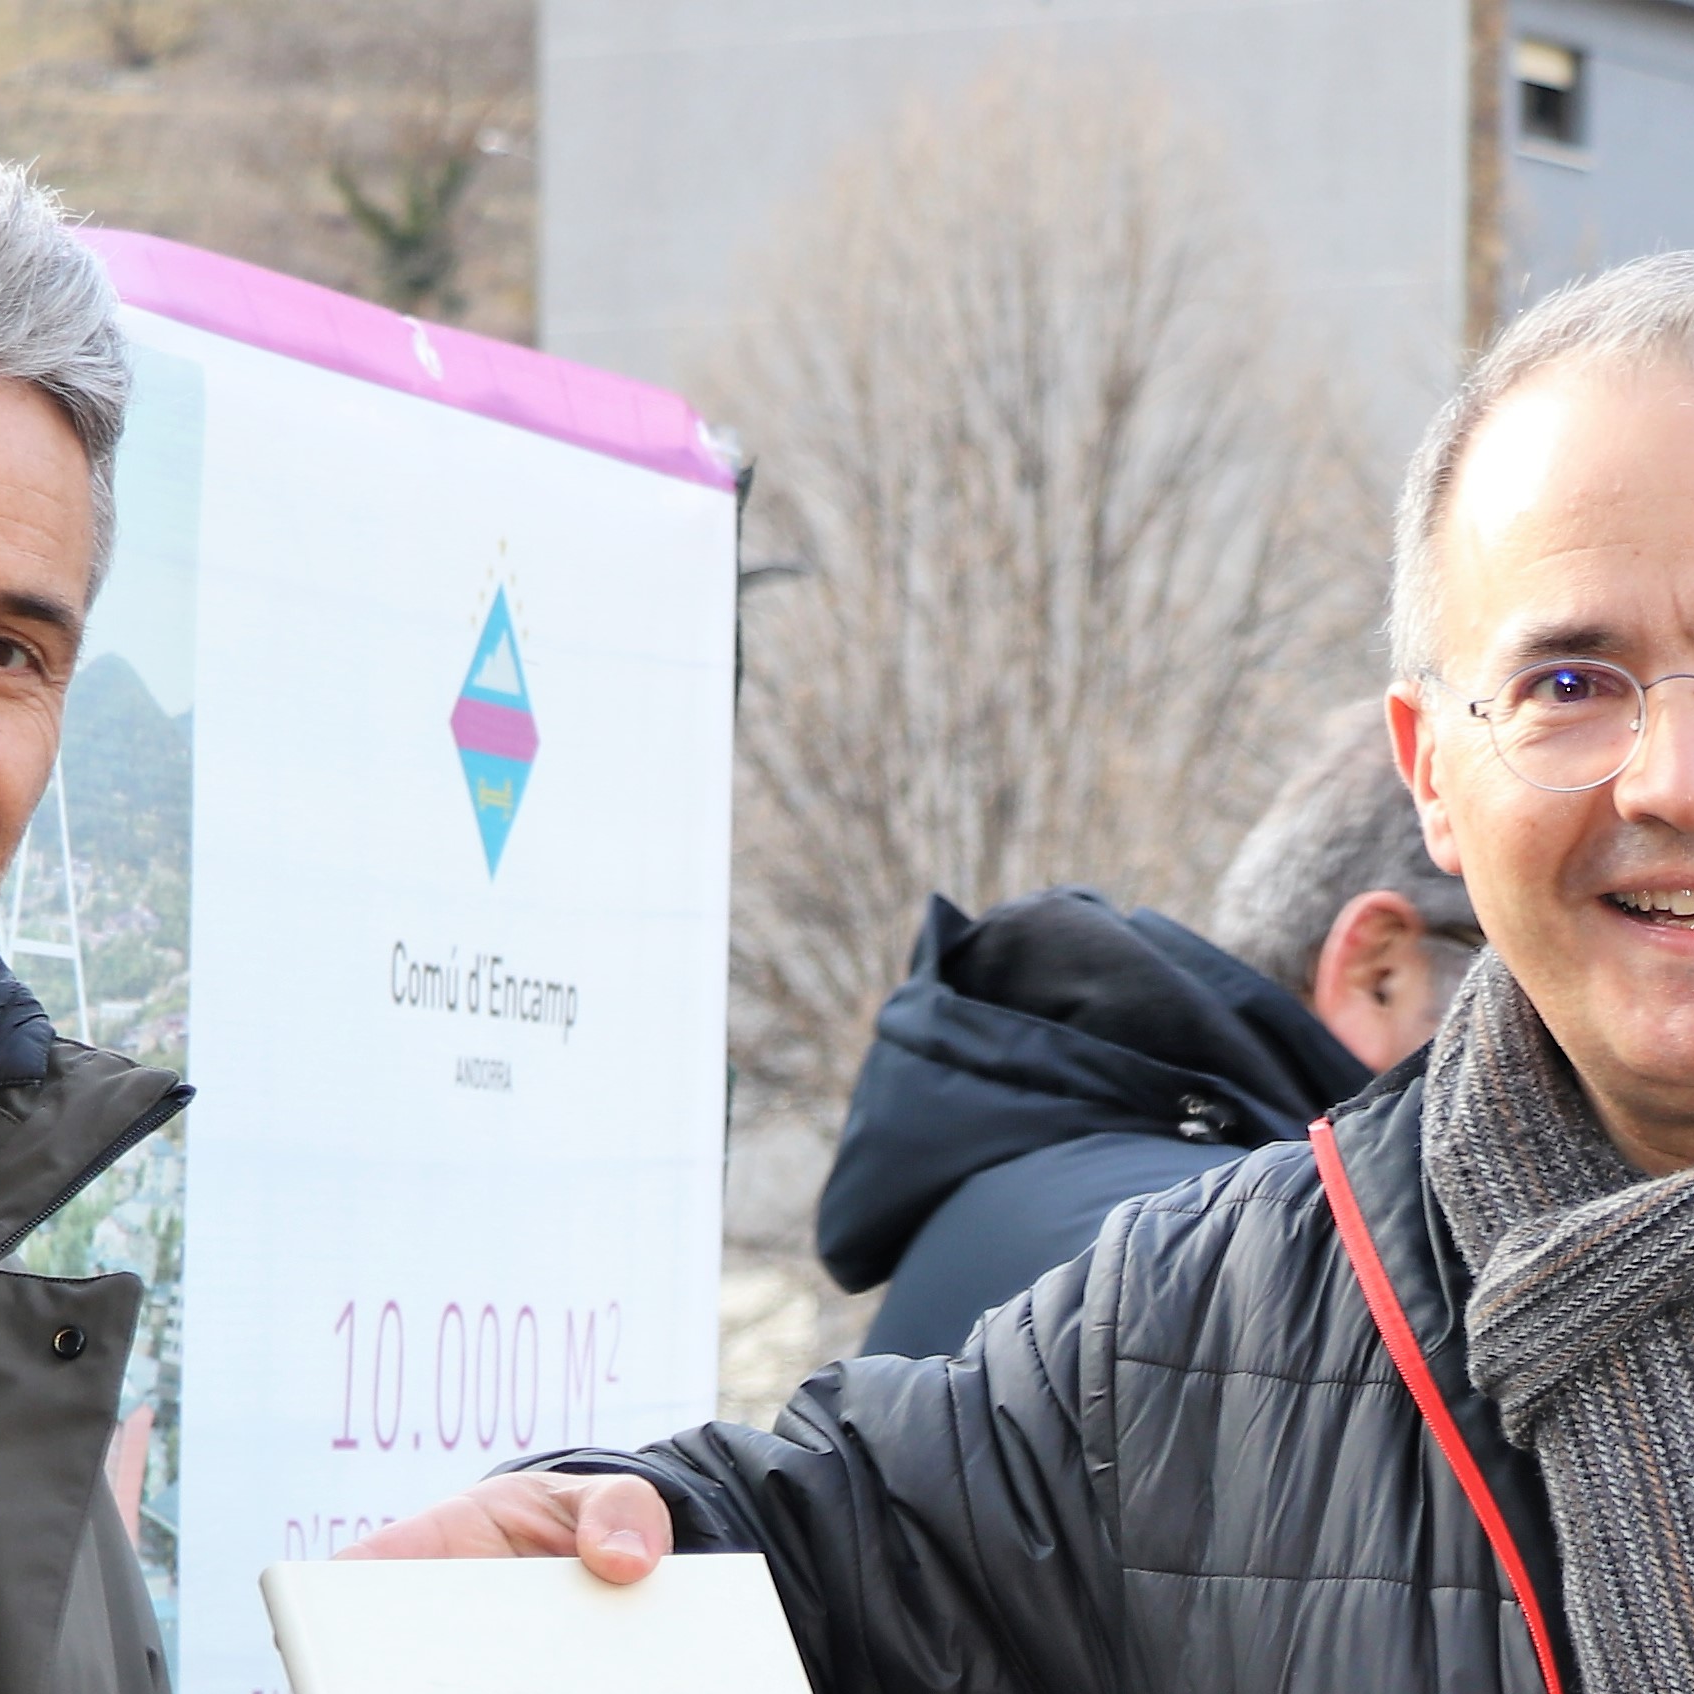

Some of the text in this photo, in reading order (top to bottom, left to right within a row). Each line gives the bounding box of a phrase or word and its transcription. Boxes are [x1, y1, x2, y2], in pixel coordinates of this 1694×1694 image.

[391, 940, 579, 1043] Comú d'Encamp
[454, 1056, 513, 1093] ANDORRA
[330, 1299, 540, 1451] 10.000
